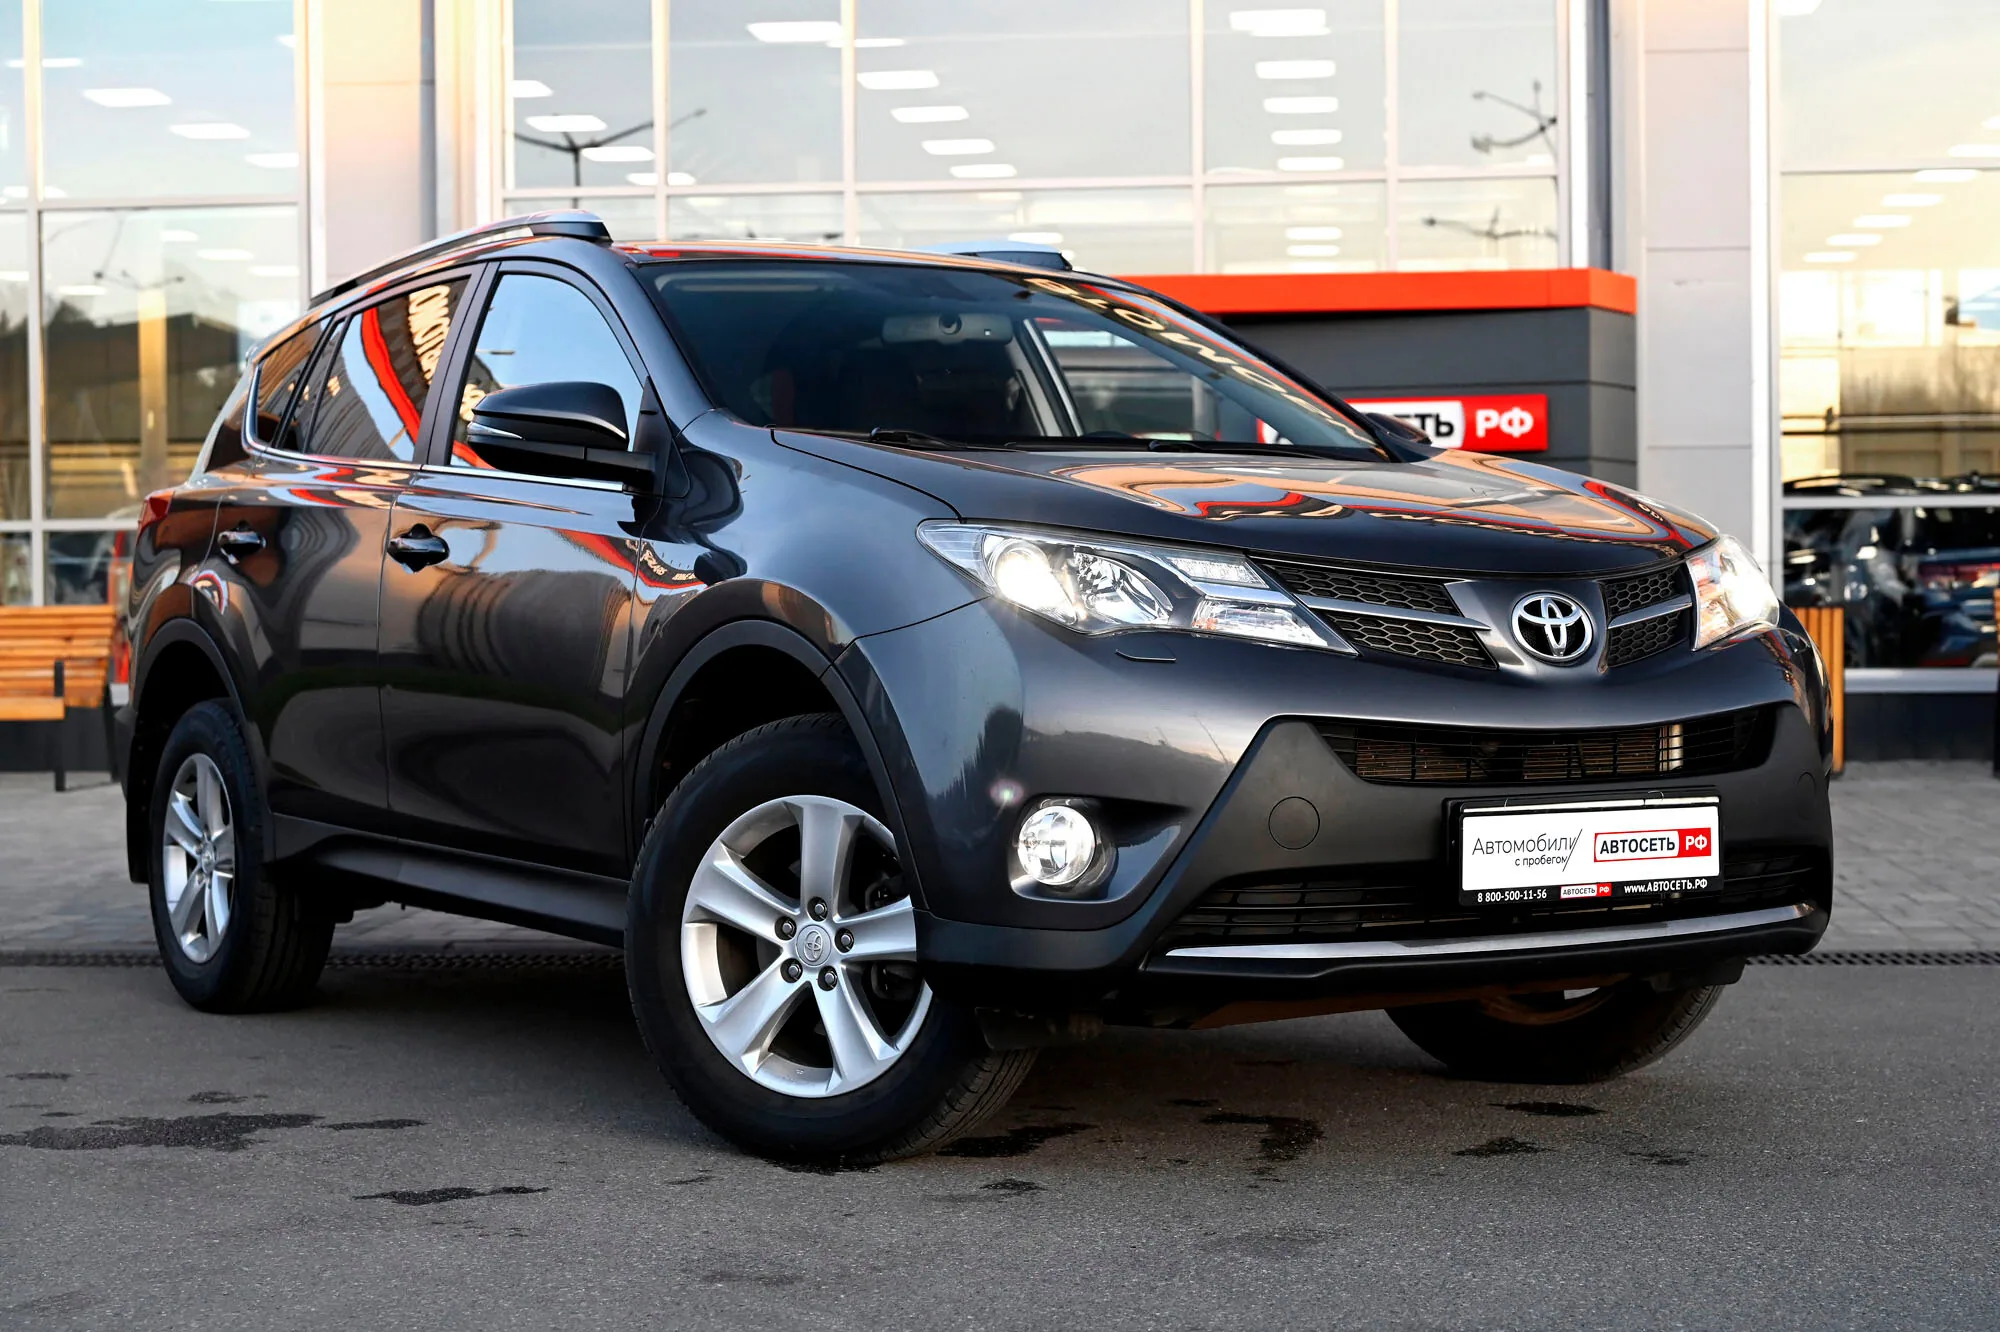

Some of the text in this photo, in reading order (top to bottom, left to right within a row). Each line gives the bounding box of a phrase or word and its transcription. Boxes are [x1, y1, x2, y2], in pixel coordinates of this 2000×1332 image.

[1475, 406, 1534, 438] РФ
[1599, 834, 1708, 855] АВТОСЕТЬ РФ
[1514, 854, 1568, 868] с пробегом
[1562, 886, 1610, 896] АВТОСЕТЬ РФ
[1624, 878, 1708, 894] www.АВТОСЕТЬ.РФ
[1477, 888, 1547, 903] 8 800-500-11-56
